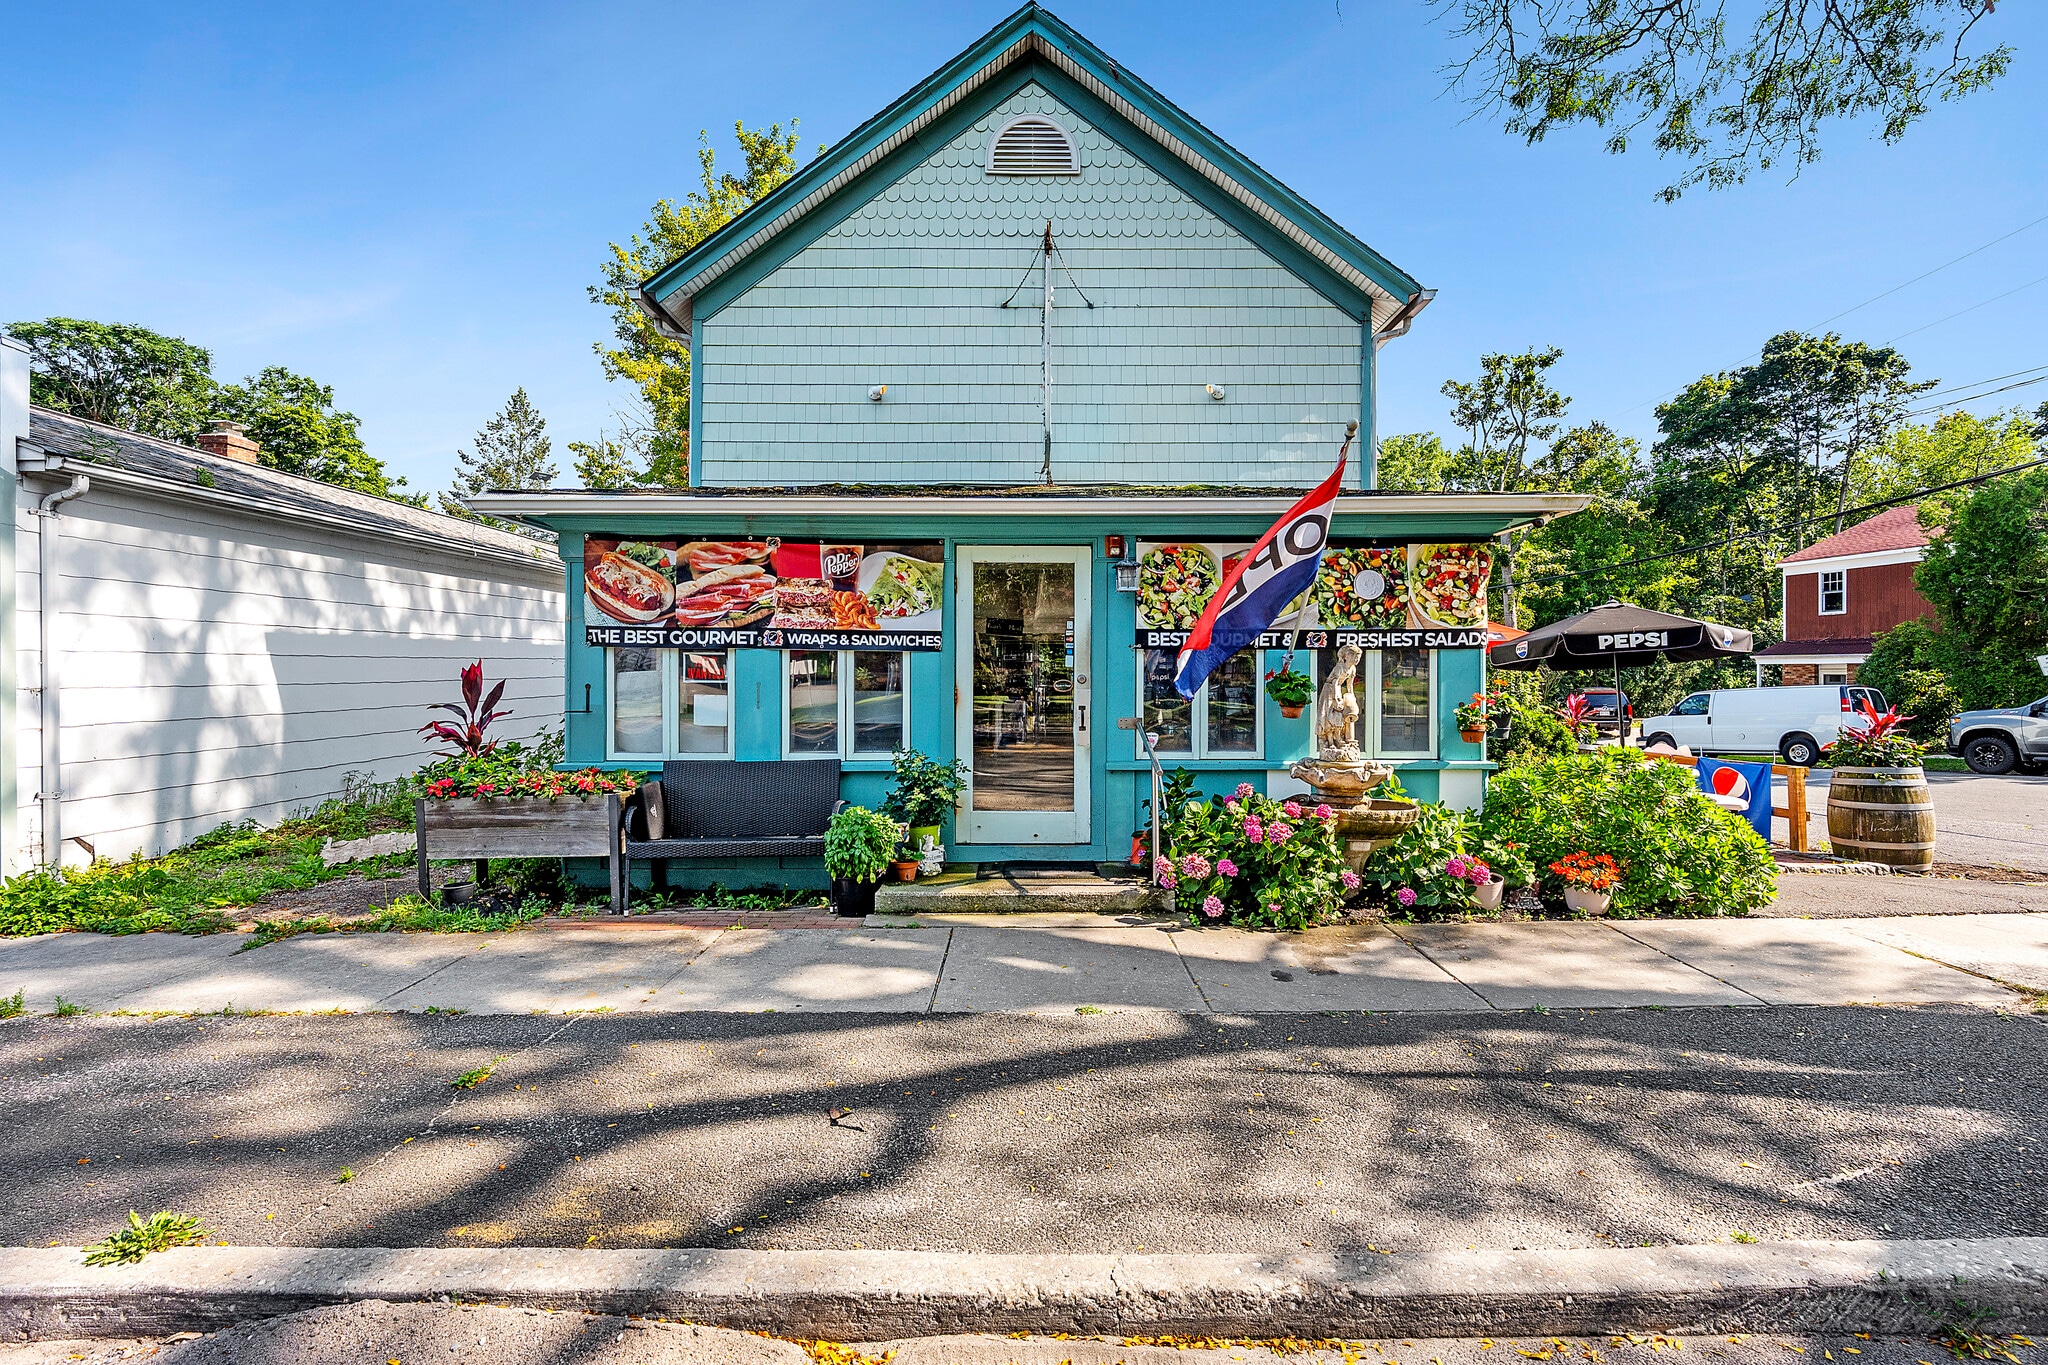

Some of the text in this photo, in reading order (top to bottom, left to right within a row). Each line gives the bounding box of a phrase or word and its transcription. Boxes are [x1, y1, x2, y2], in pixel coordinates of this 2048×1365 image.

[825, 555, 858, 575] Pepper
[836, 552, 851, 564] Dr
[588, 629, 758, 645] THE BEST GOURMET
[787, 632, 942, 647] WRAPS & SANDWICHES
[1147, 632, 1191, 647] BEST
[1281, 632, 1293, 647] &
[1335, 632, 1423, 647] FRESHEST
[1424, 631, 1487, 646] SALADS
[1598, 631, 1668, 649] PEPSI
